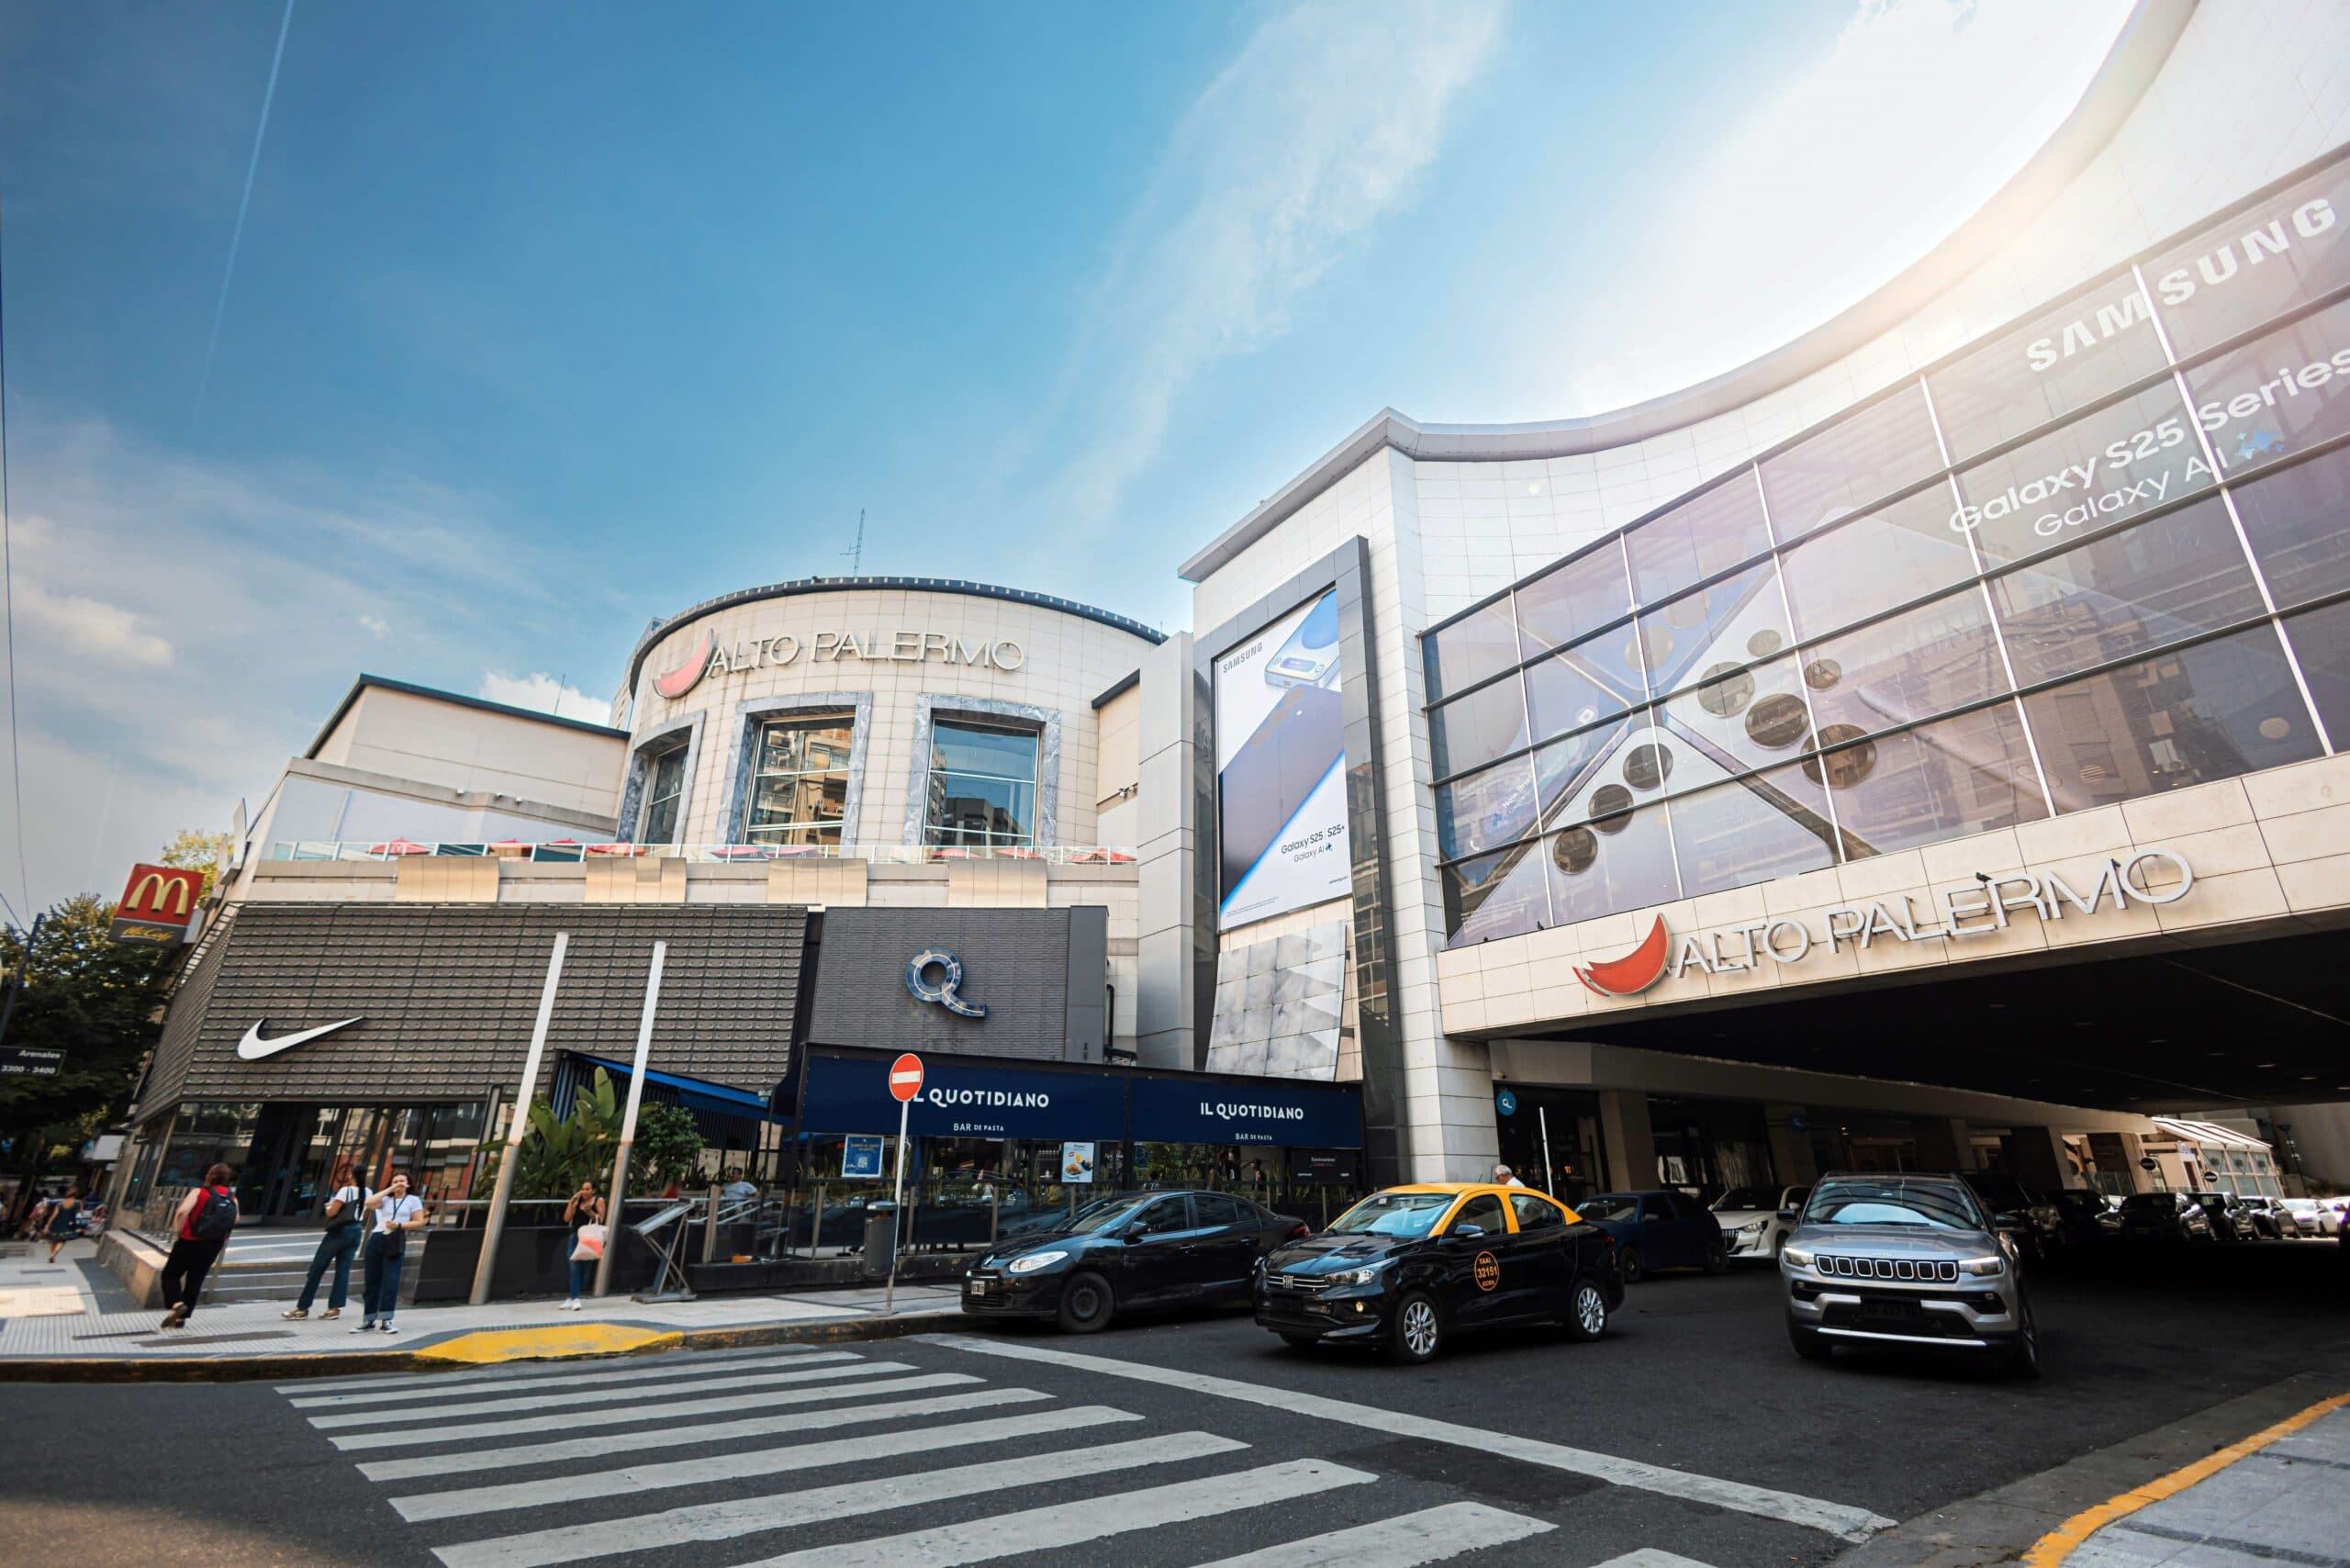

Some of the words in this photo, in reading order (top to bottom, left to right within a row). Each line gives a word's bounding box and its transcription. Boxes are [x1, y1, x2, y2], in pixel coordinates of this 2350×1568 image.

[2027, 199, 2336, 372] SAMSUNG
[1949, 456, 2096, 532] Galaxy
[2105, 419, 2185, 468] S25
[2034, 471, 2170, 536] Galaxy
[2185, 446, 2229, 483] AI
[705, 635, 800, 677] ALTO
[811, 632, 1024, 671] PALERMO
[1223, 642, 1262, 674] SAMSUNG
[1281, 837, 1309, 855] Galaxy
[1310, 831, 1324, 844] S25
[1293, 848, 1317, 863] Galaxy
[1318, 845, 1325, 854] AI
[1674, 918, 1812, 979] ALTO
[1823, 848, 2195, 956] PALERMO
[905, 946, 986, 1018] Q
[18, 1049, 61, 1059] Arenales
[929, 1088, 1049, 1108] QUOTIDIANO
[1200, 1102, 1214, 1115] IL
[1216, 1103, 1304, 1120] QUOTIDIANO
[953, 1123, 972, 1132] BAR
[1479, 1257, 1492, 1265] TAXI
